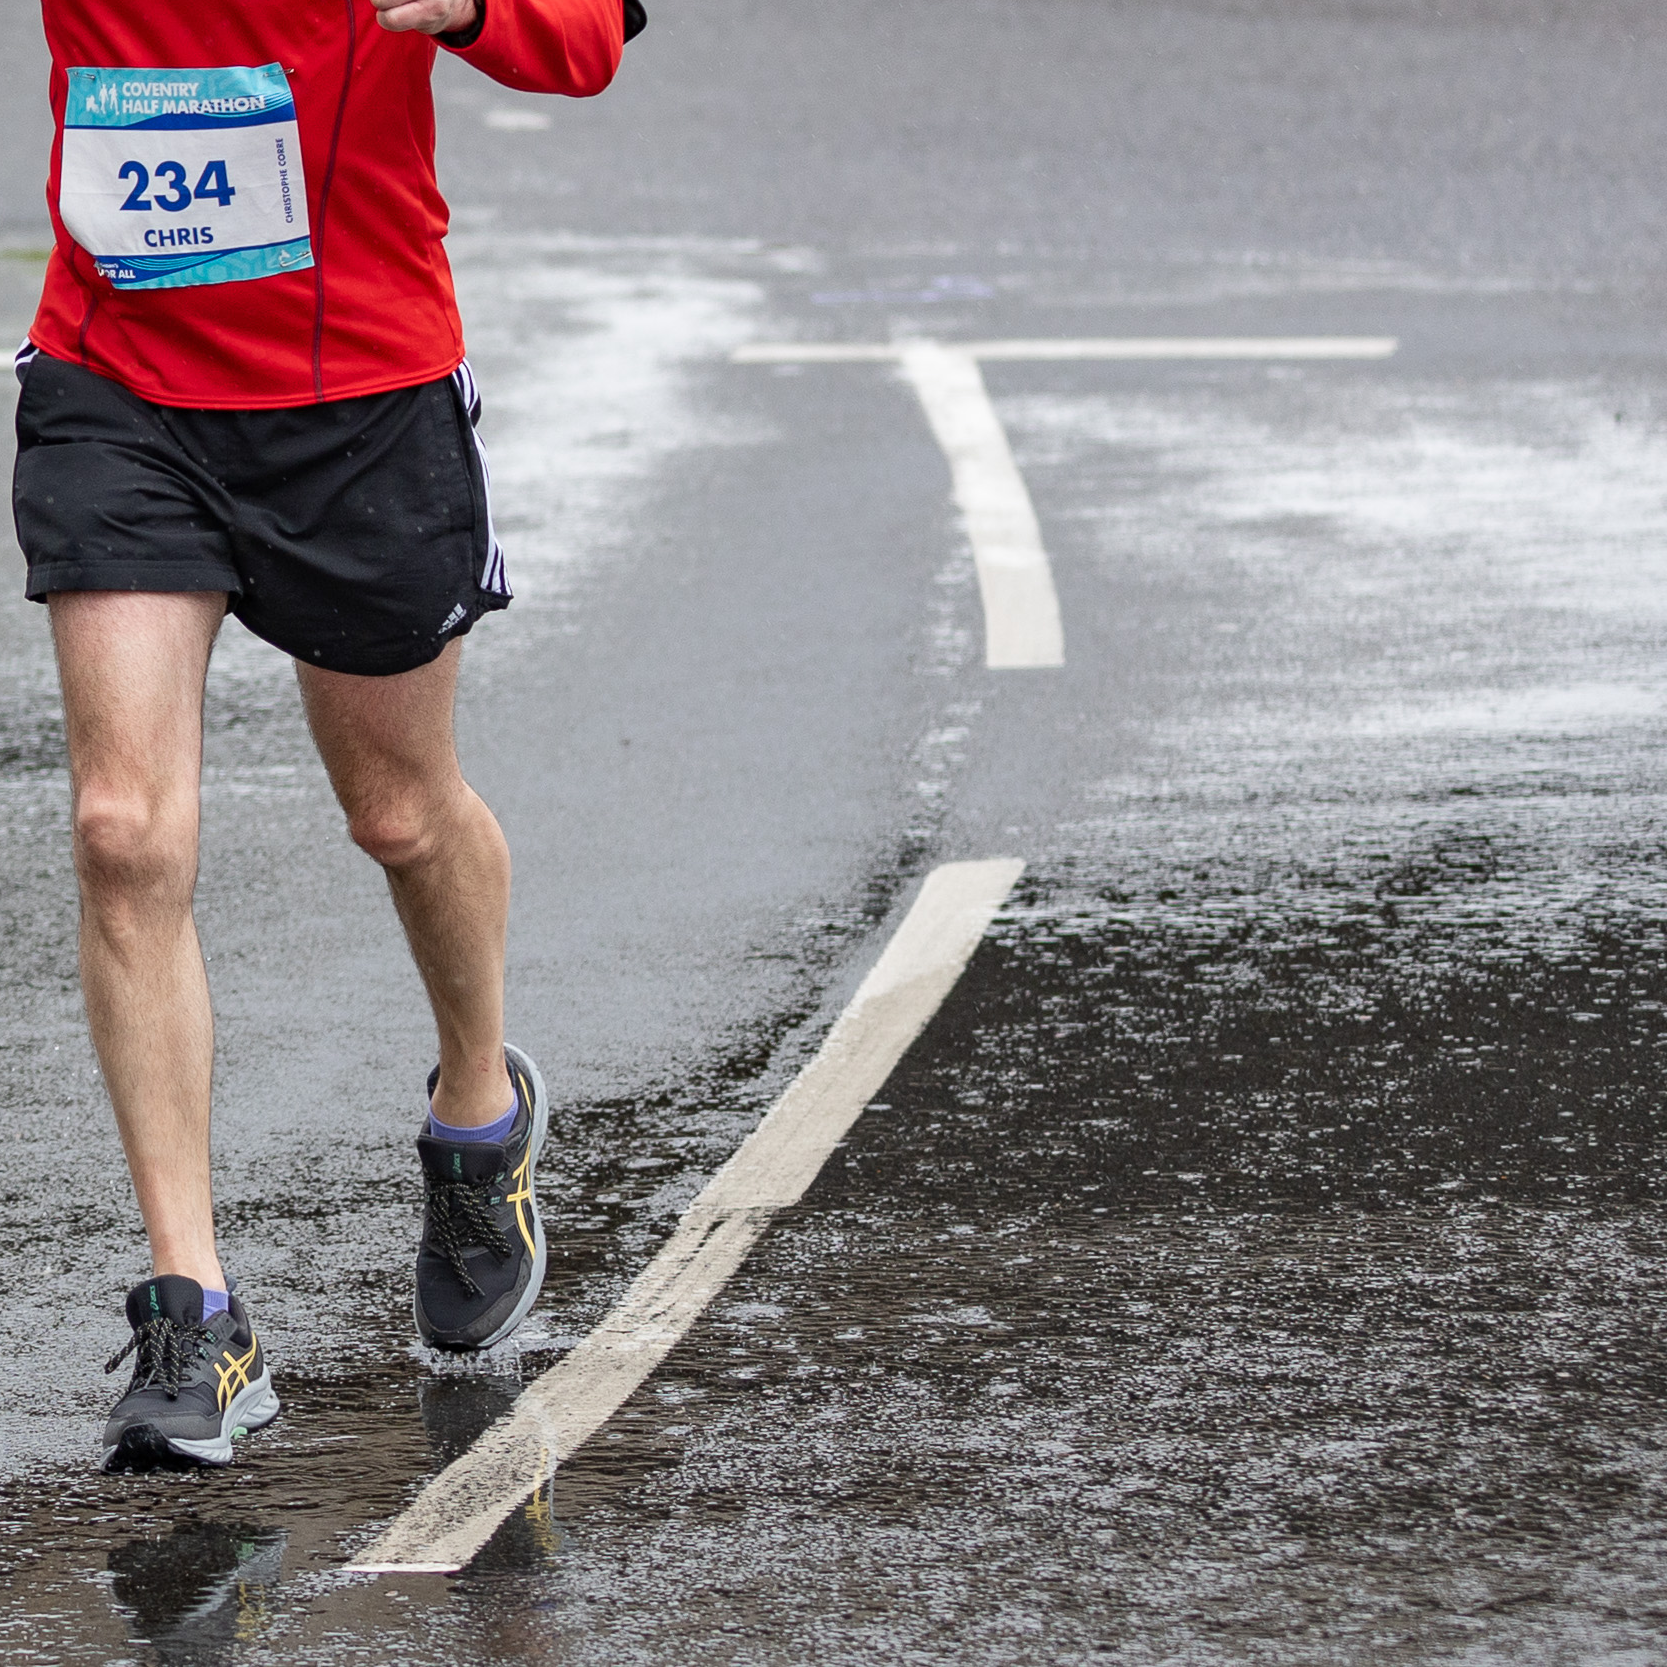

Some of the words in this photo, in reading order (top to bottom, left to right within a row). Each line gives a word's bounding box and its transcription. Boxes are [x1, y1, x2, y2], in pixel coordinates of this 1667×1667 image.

[122, 82, 200, 97] COVENTRY
[122, 99, 159, 114] HALF
[161, 95, 267, 115] MARATHON
[117, 160, 236, 212] 234
[279, 169, 294, 224] CHRISTOPHE
[143, 227, 214, 247] CHRIS
